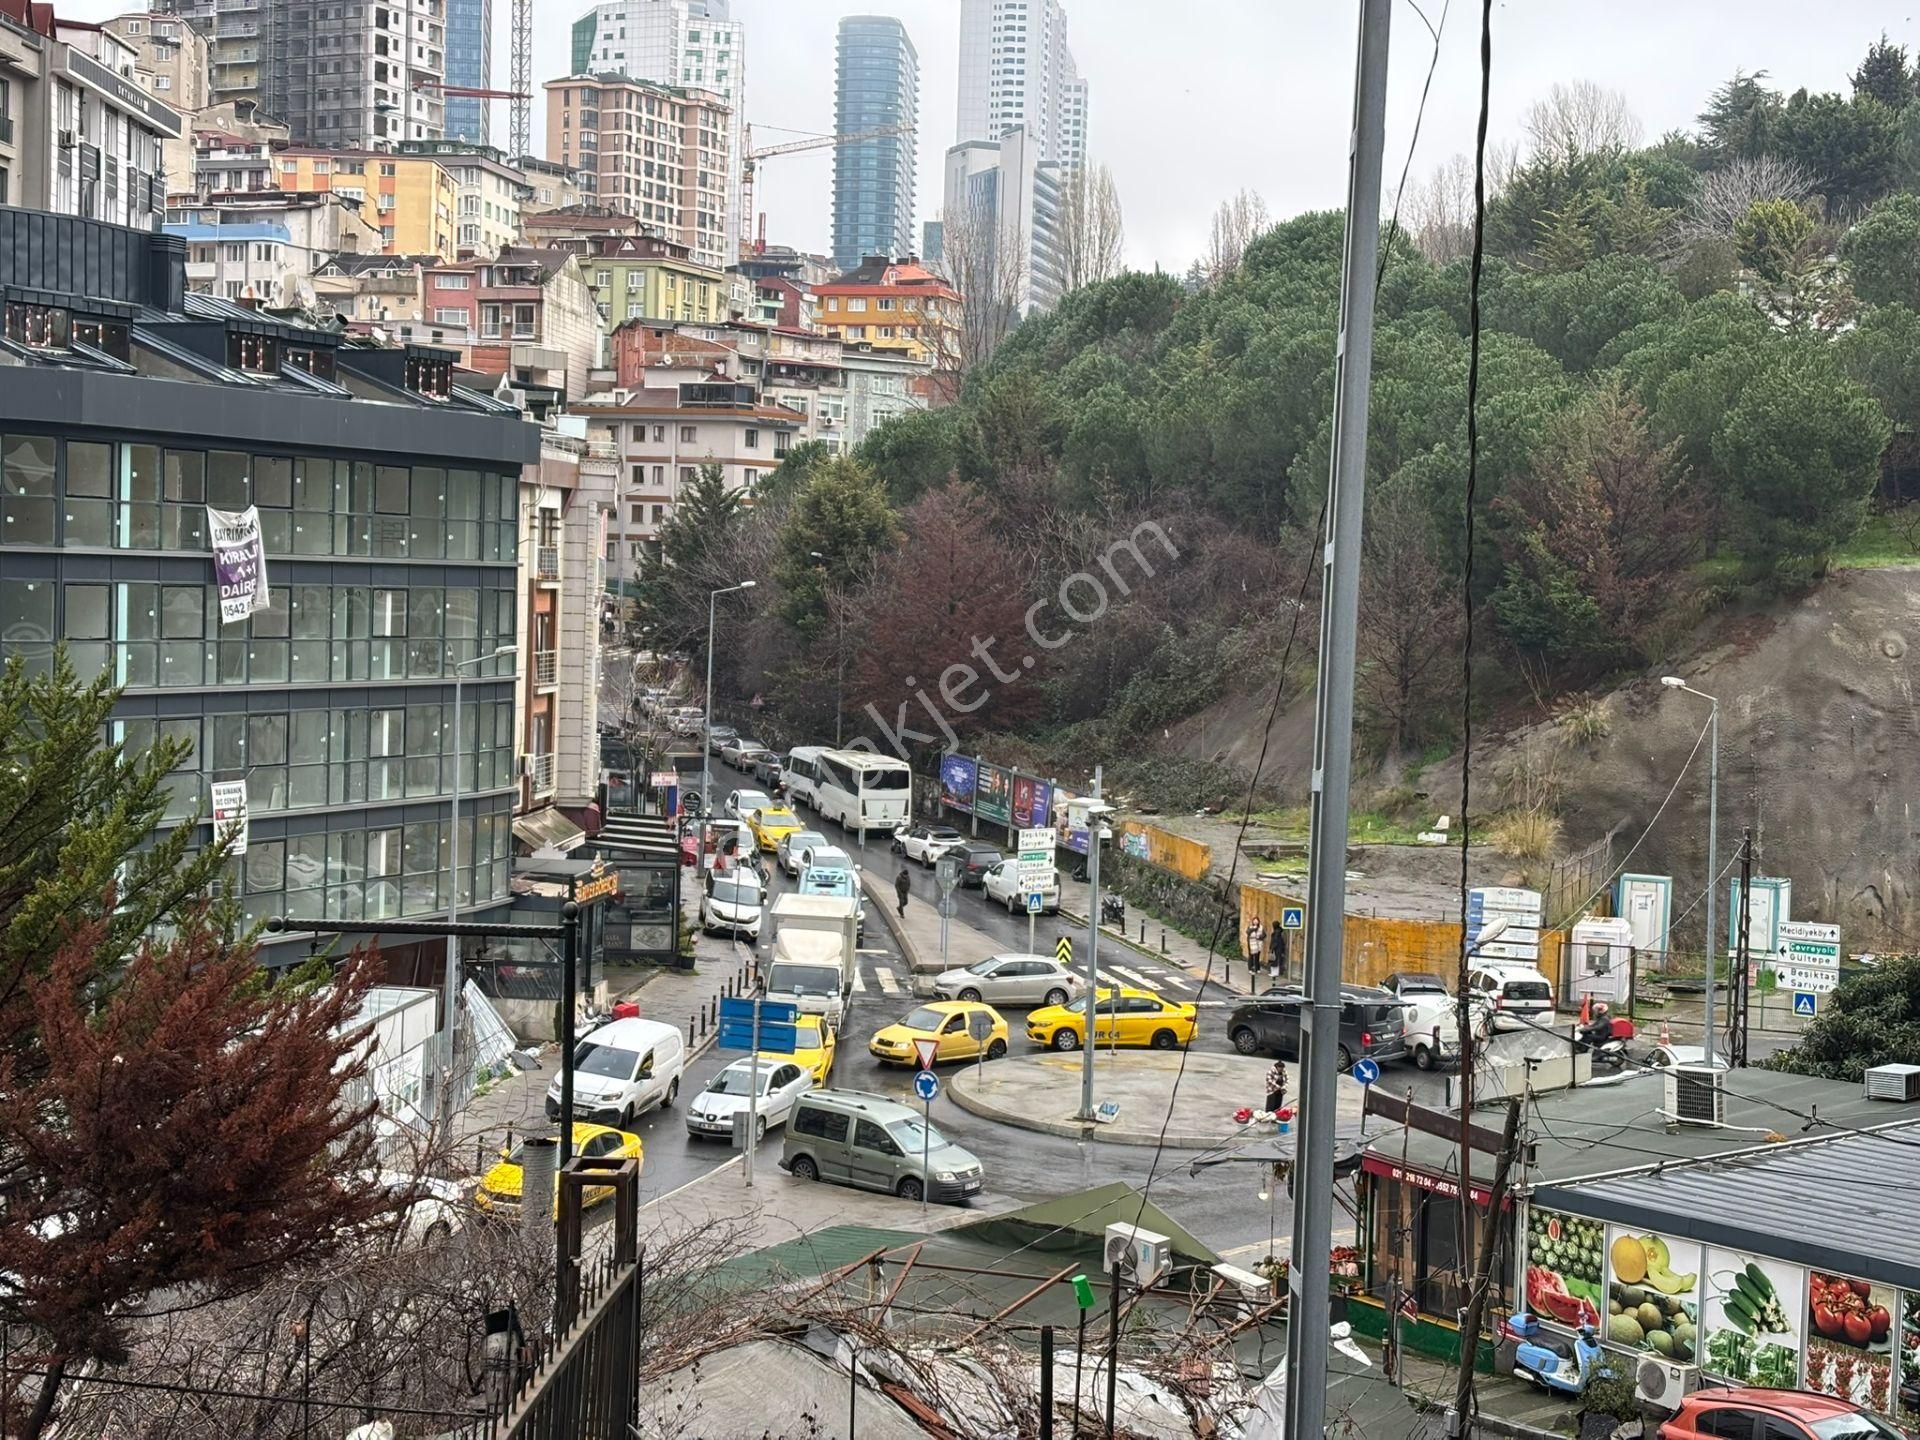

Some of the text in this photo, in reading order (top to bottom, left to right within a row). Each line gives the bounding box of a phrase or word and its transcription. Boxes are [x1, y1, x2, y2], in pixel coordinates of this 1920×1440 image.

[237, 562, 256, 578] 1+1
[223, 602, 246, 617] 0542
[1780, 926, 1827, 938] Mecidiyeköy
[1790, 944, 1836, 955] Çevreyolu
[1789, 953, 1831, 964] Gültepe
[1790, 979, 1831, 991] Sarıyer
[1392, 1168, 1404, 1179] 021
